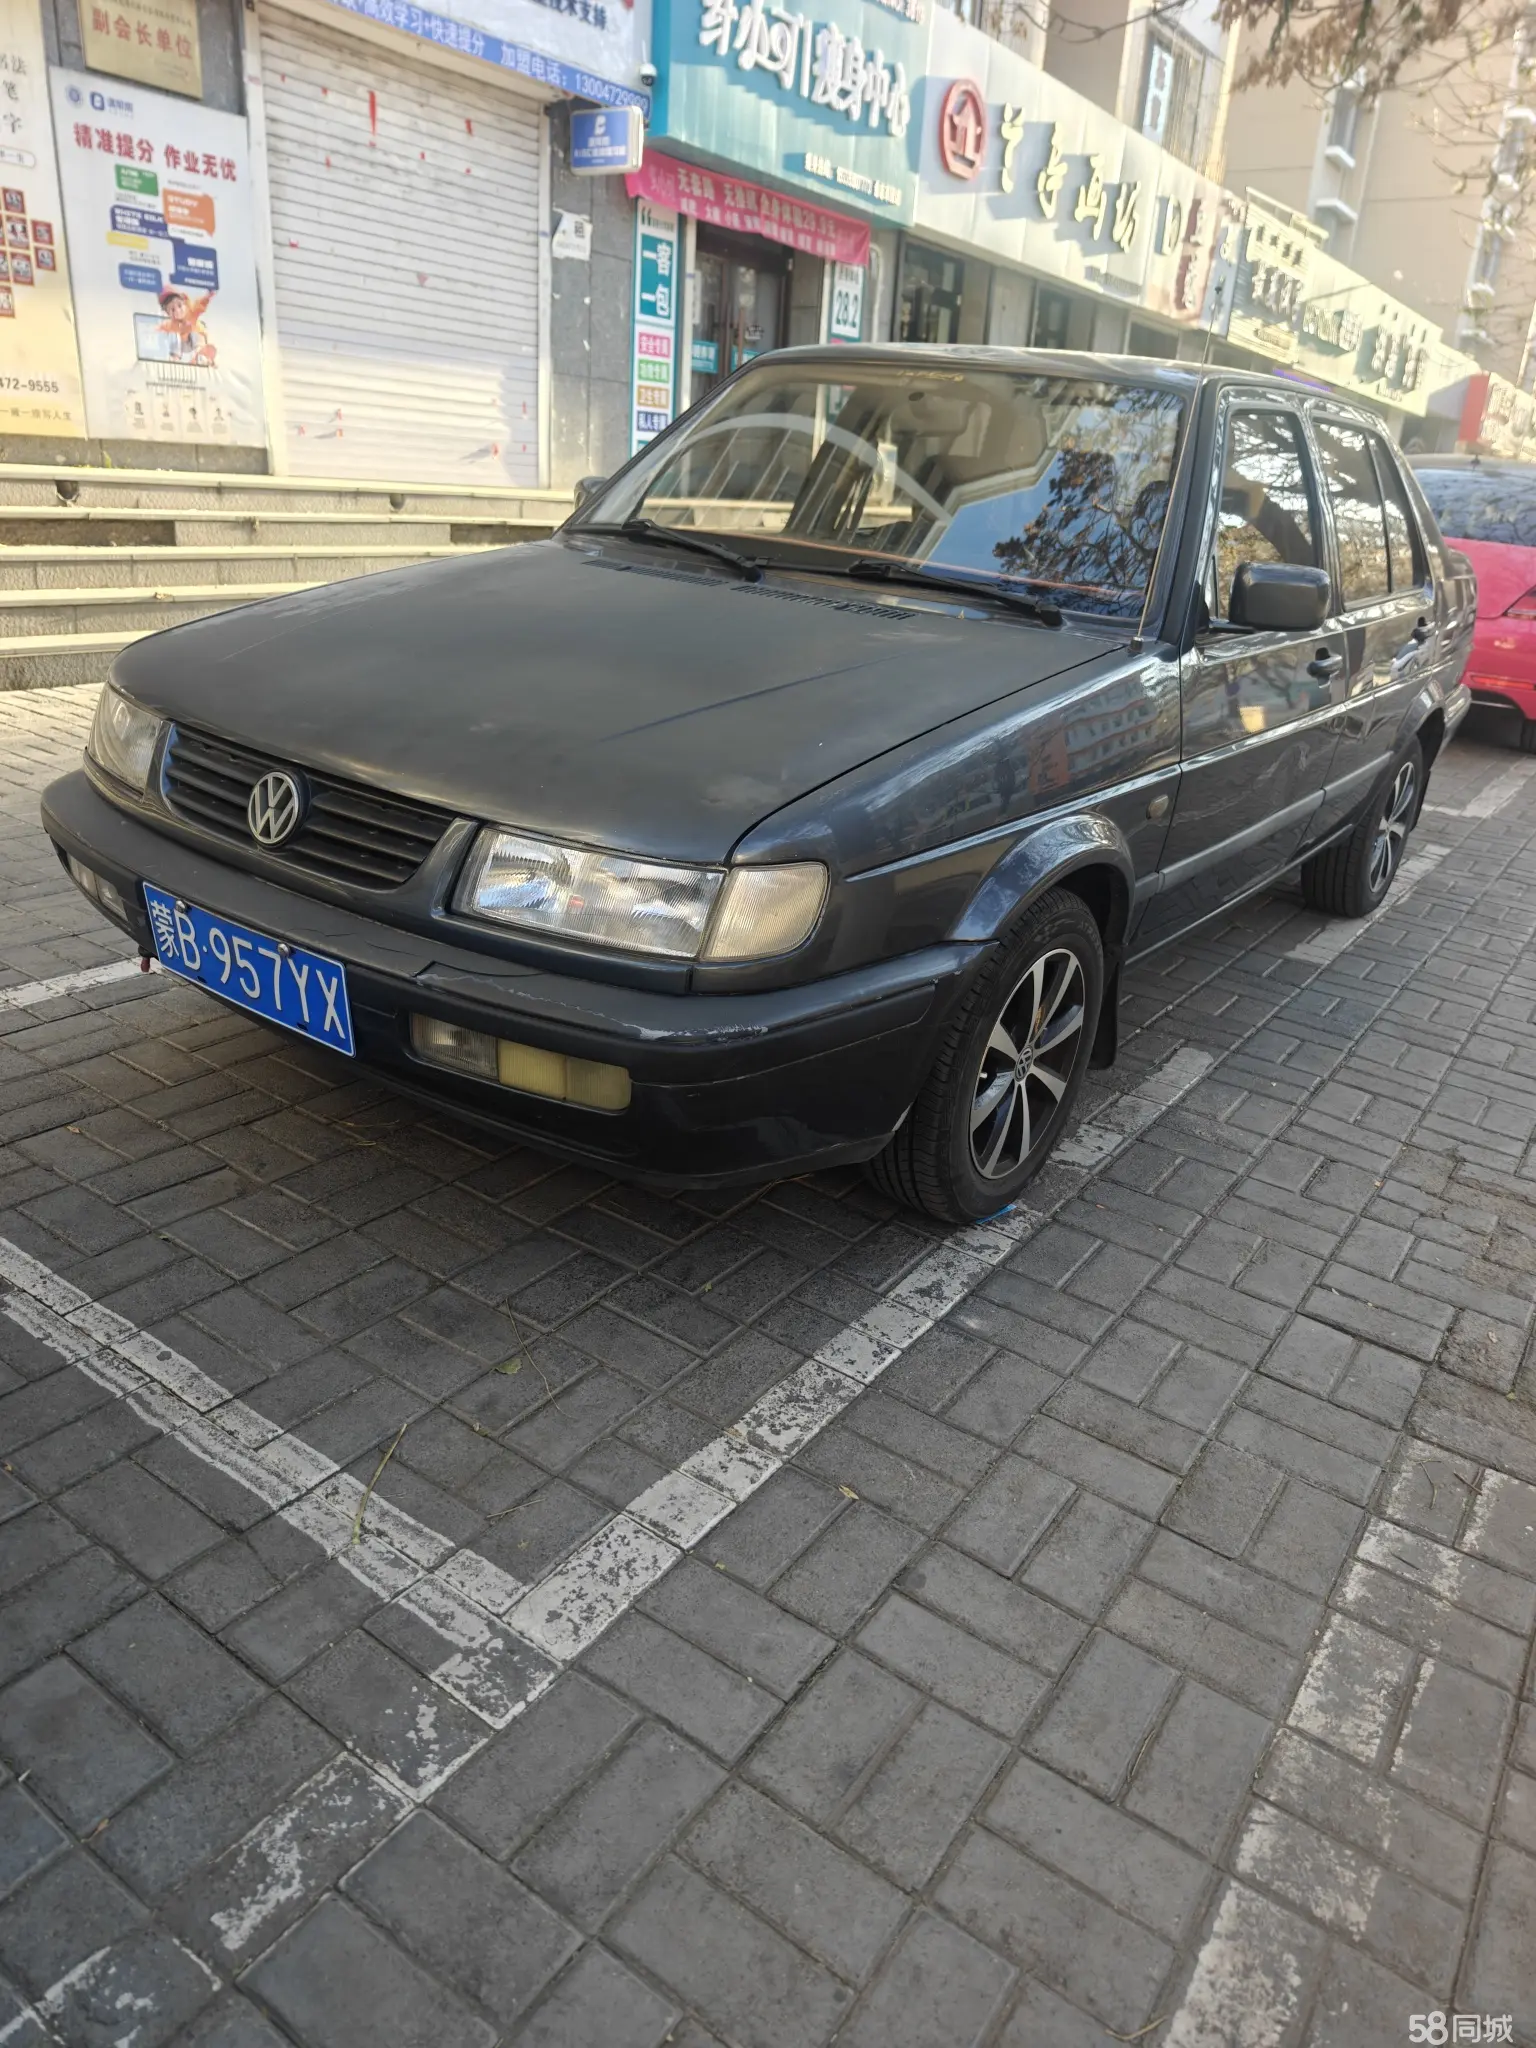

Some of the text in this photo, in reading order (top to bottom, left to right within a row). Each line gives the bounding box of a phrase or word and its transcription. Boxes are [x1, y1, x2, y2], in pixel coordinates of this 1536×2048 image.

[91, 6, 193, 60] 副会长单位
[73, 122, 154, 164] 精准提分
[164, 144, 237, 182] 作业无忧
